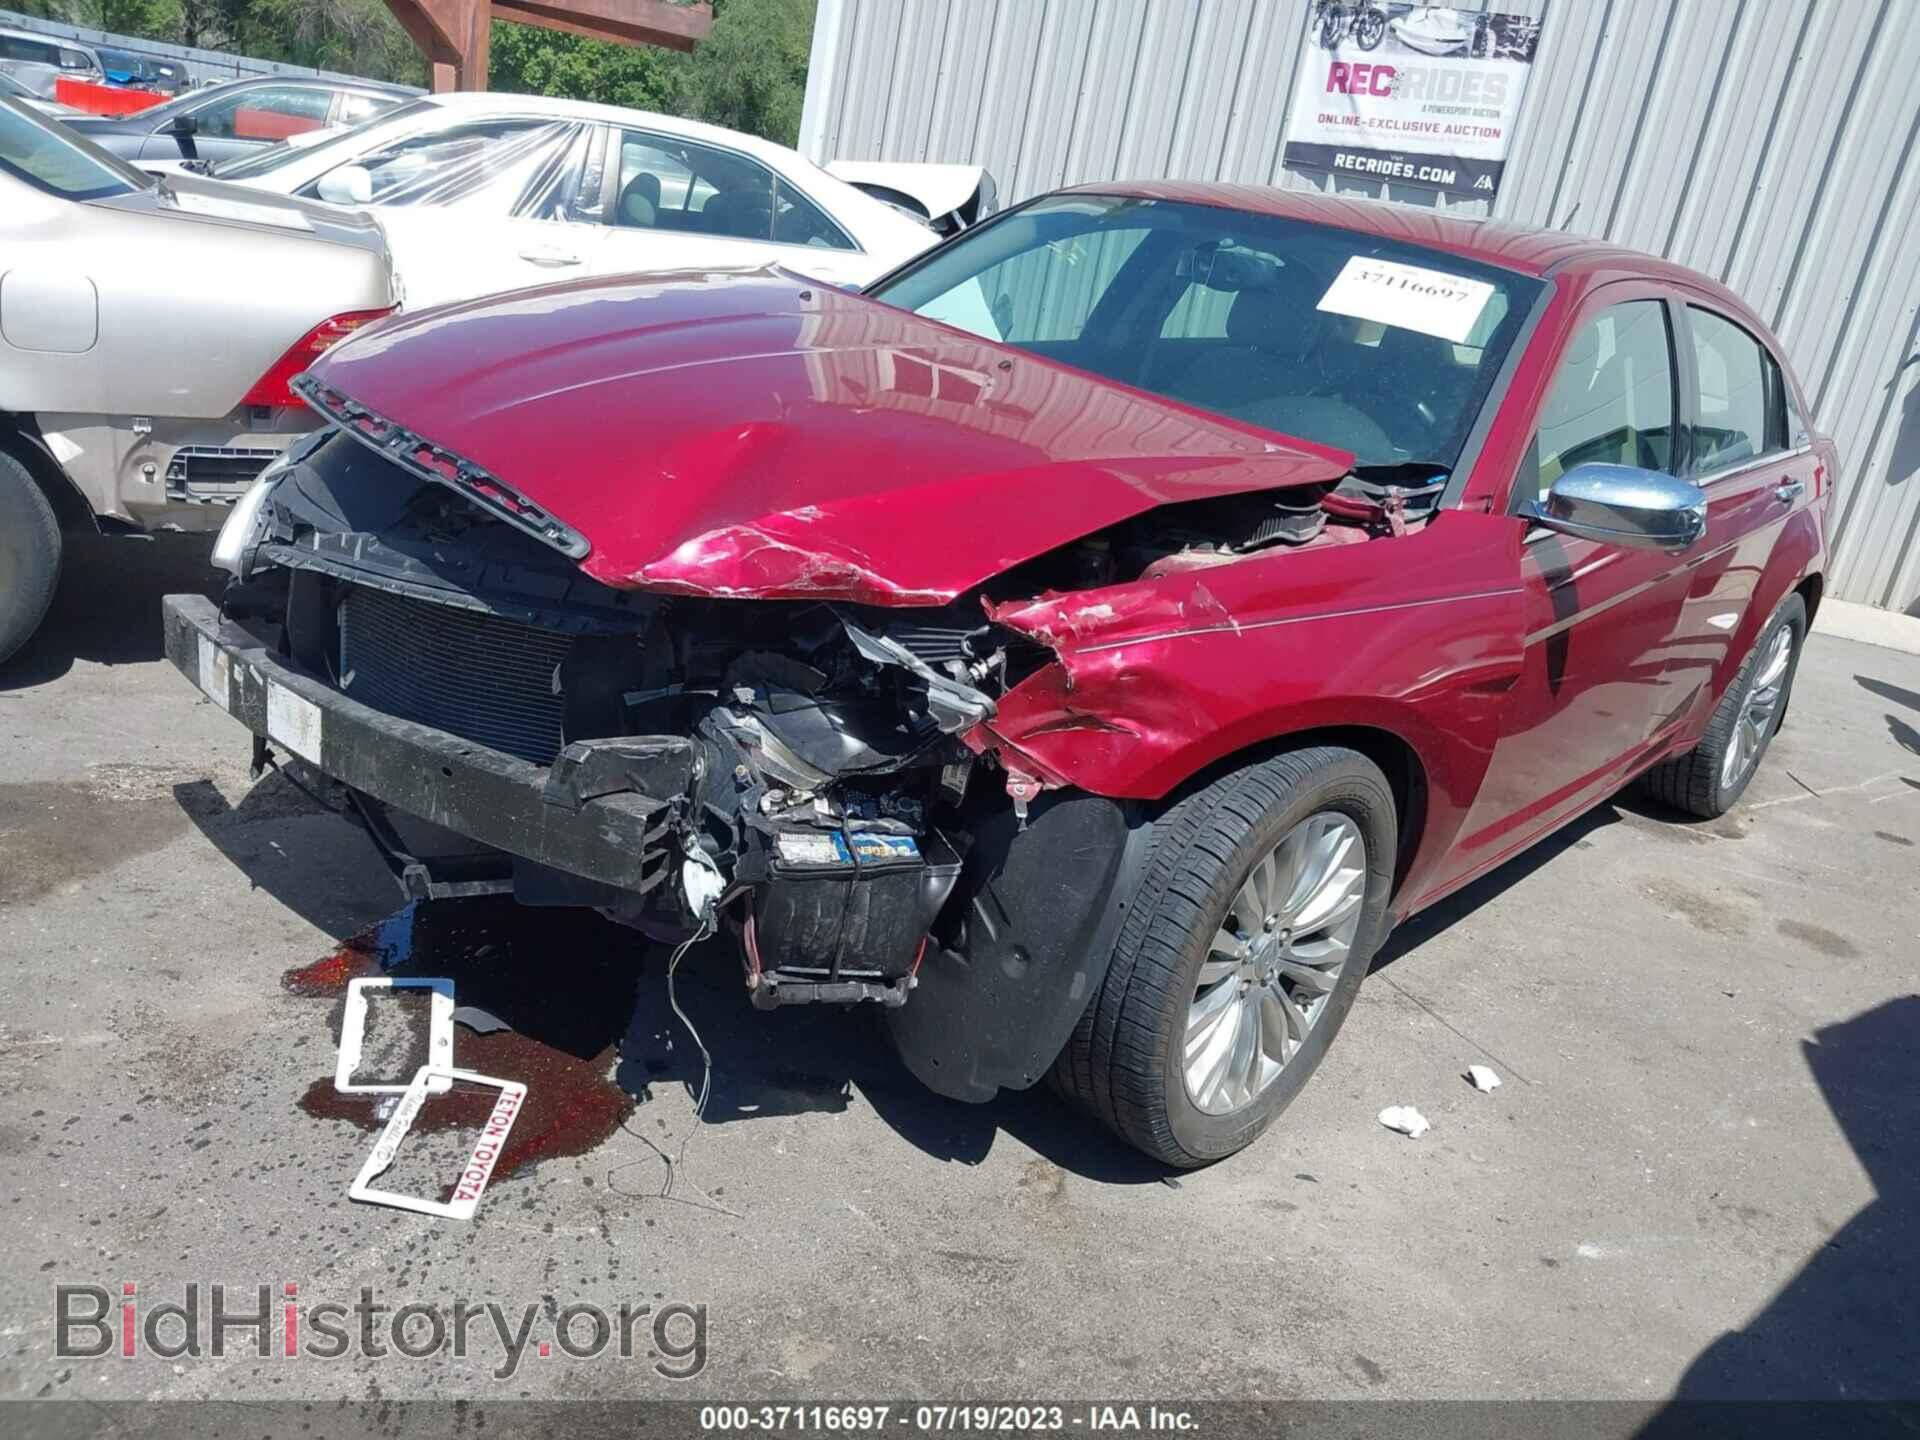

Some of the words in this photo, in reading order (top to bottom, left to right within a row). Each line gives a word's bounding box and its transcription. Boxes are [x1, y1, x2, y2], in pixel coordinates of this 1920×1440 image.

[1317, 113, 1441, 134] ONLINE-EXCLUSIVE
[1444, 124, 1502, 139] AUCTION
[1334, 153, 1457, 185] RECRIDES.COM
[1353, 270, 1469, 302] 37116697
[484, 1091, 521, 1138] TETON
[454, 1142, 498, 1201] TOYOTA
